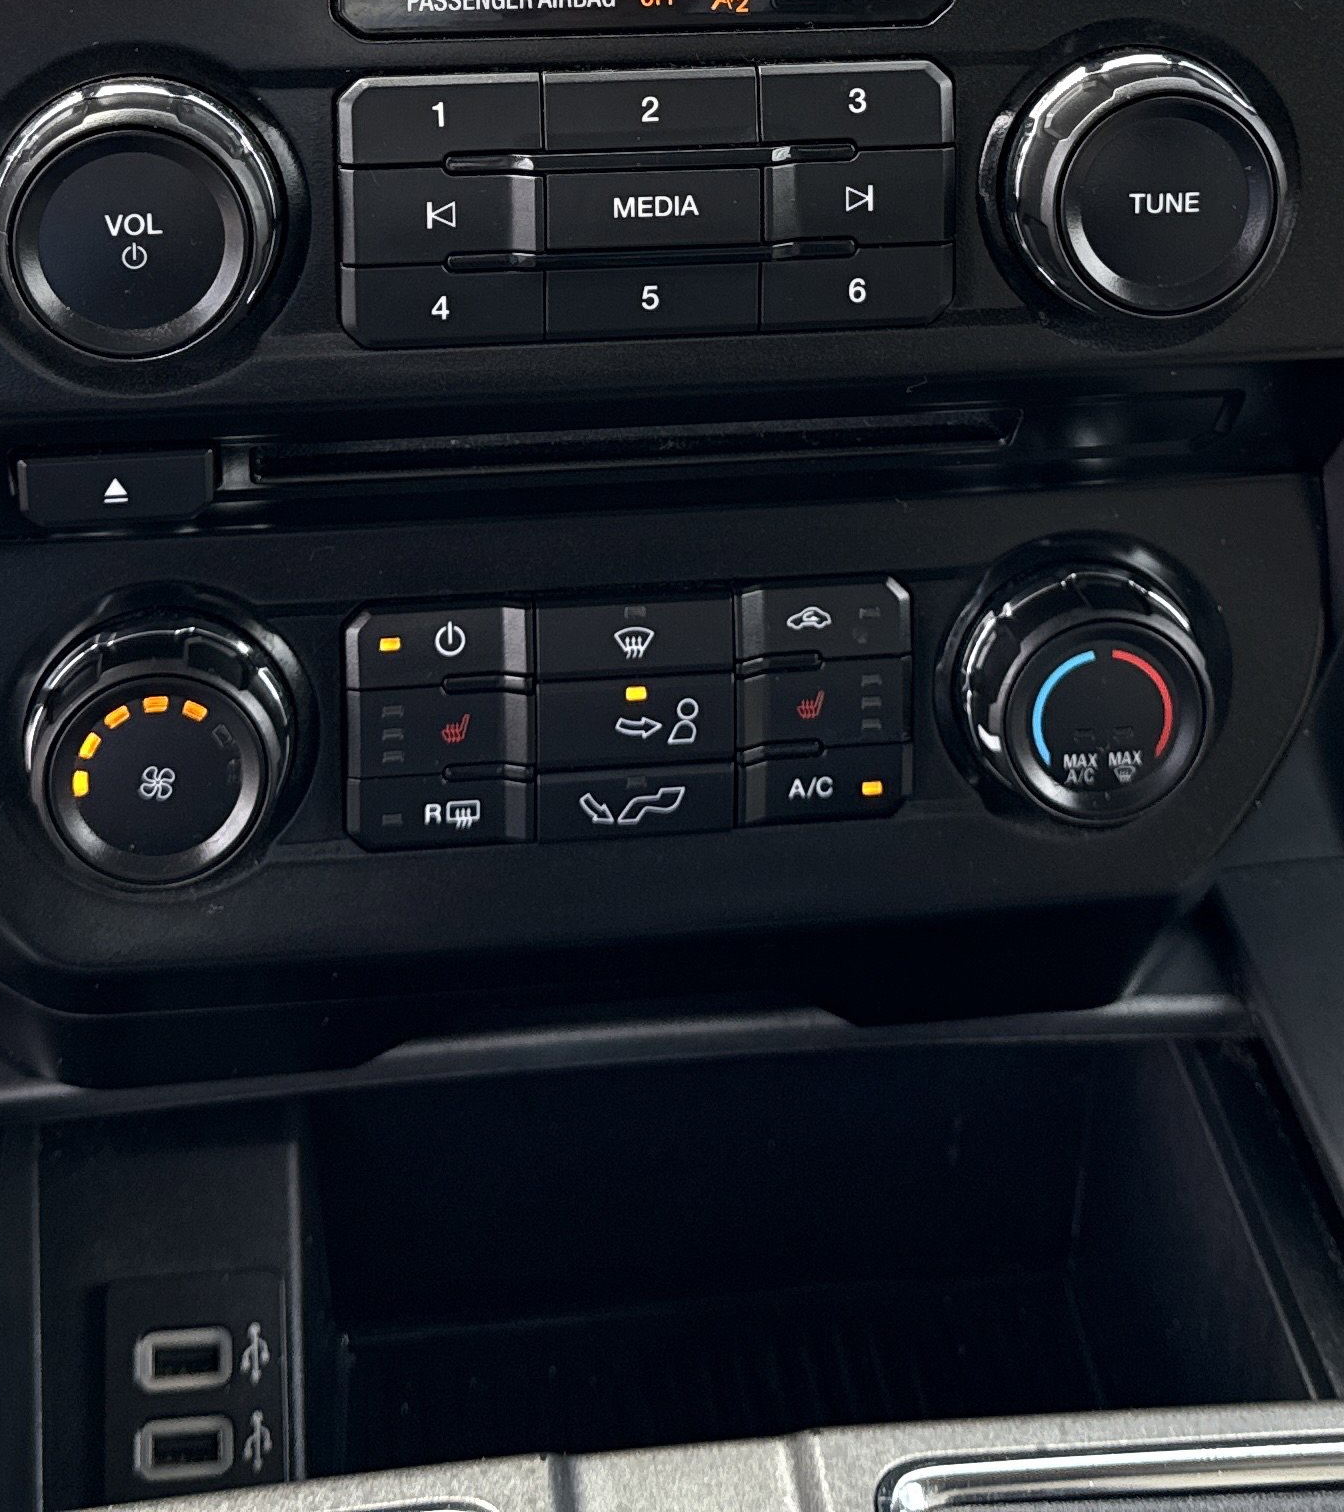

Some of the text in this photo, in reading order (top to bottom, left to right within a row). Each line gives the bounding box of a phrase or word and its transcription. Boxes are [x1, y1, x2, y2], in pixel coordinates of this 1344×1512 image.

[641, 97, 660, 123] 2
[848, 87, 867, 114] 3
[432, 101, 445, 127] 1
[612, 194, 700, 220] MEDIA
[1129, 192, 1200, 215] TUNE
[105, 214, 163, 237] VOL
[641, 285, 660, 311] 5
[848, 278, 867, 304] 6
[431, 296, 450, 320] 4
[1063, 753, 1098, 769] MAX
[1108, 750, 1143, 766] MAX
[789, 776, 833, 800] A/C
[1065, 768, 1095, 784] A/C
[425, 804, 441, 825] R
